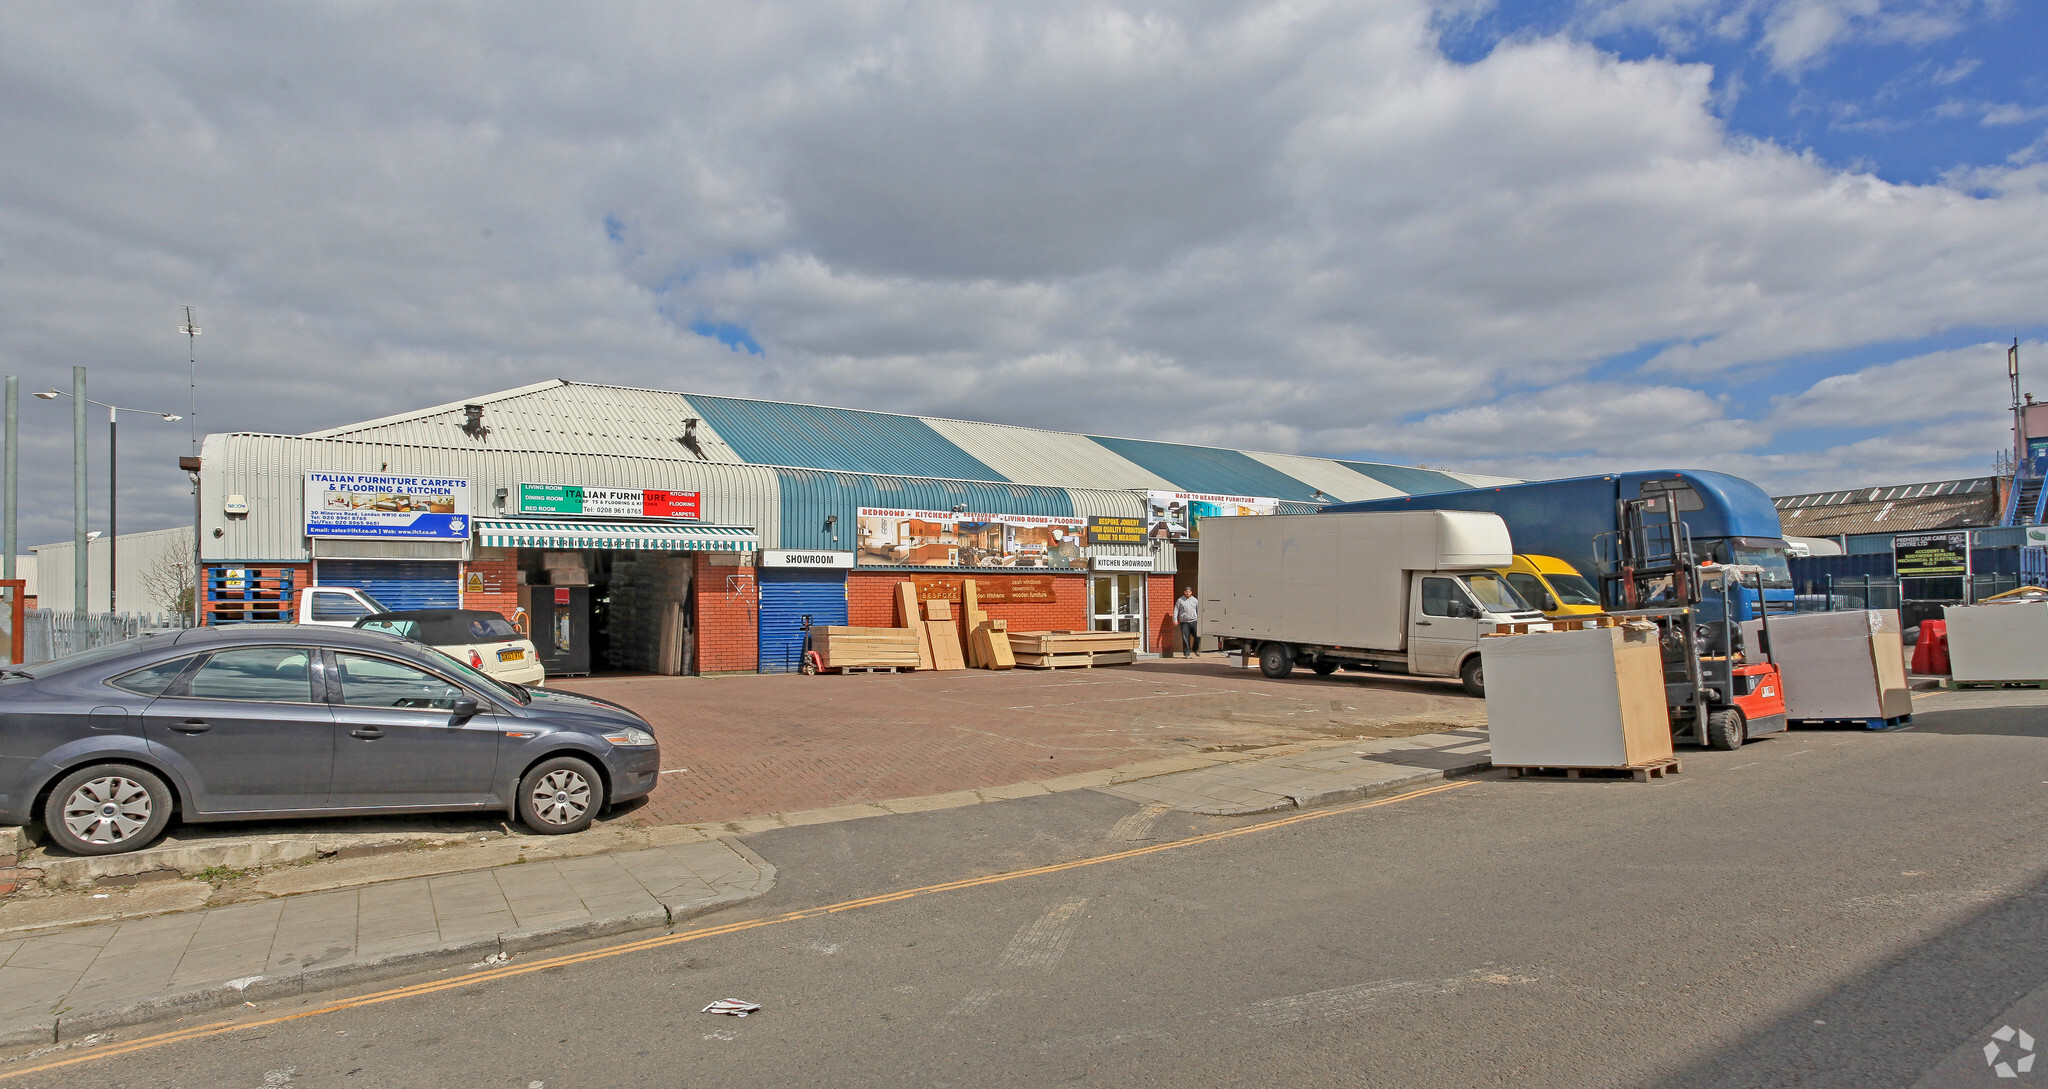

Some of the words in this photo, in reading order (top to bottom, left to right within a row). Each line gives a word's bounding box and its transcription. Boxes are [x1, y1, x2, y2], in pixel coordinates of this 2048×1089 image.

[311, 474, 354, 483] ITALIAN
[358, 476, 417, 485] FURNITURE
[421, 479, 467, 488] CARPETS
[340, 484, 393, 493] FLOORING
[407, 487, 450, 495] KITCHEN
[565, 490, 606, 499] ITALIAN
[610, 492, 666, 502] FURNITURE
[1200, 494, 1224, 502] MEASURE
[1226, 496, 1255, 504] FURNITURE
[862, 508, 905, 517] BEDROOMS
[915, 511, 953, 519] KITCHENS
[513, 538, 548, 546] ITALIAN
[551, 538, 599, 547] FURNITURE
[602, 540, 640, 548] CARPETS
[650, 541, 690, 549] FLOORING
[785, 554, 834, 564] SHOWROOM
[1098, 559, 1121, 567] KITCHEN
[1122, 560, 1152, 568] SHOWROOM
